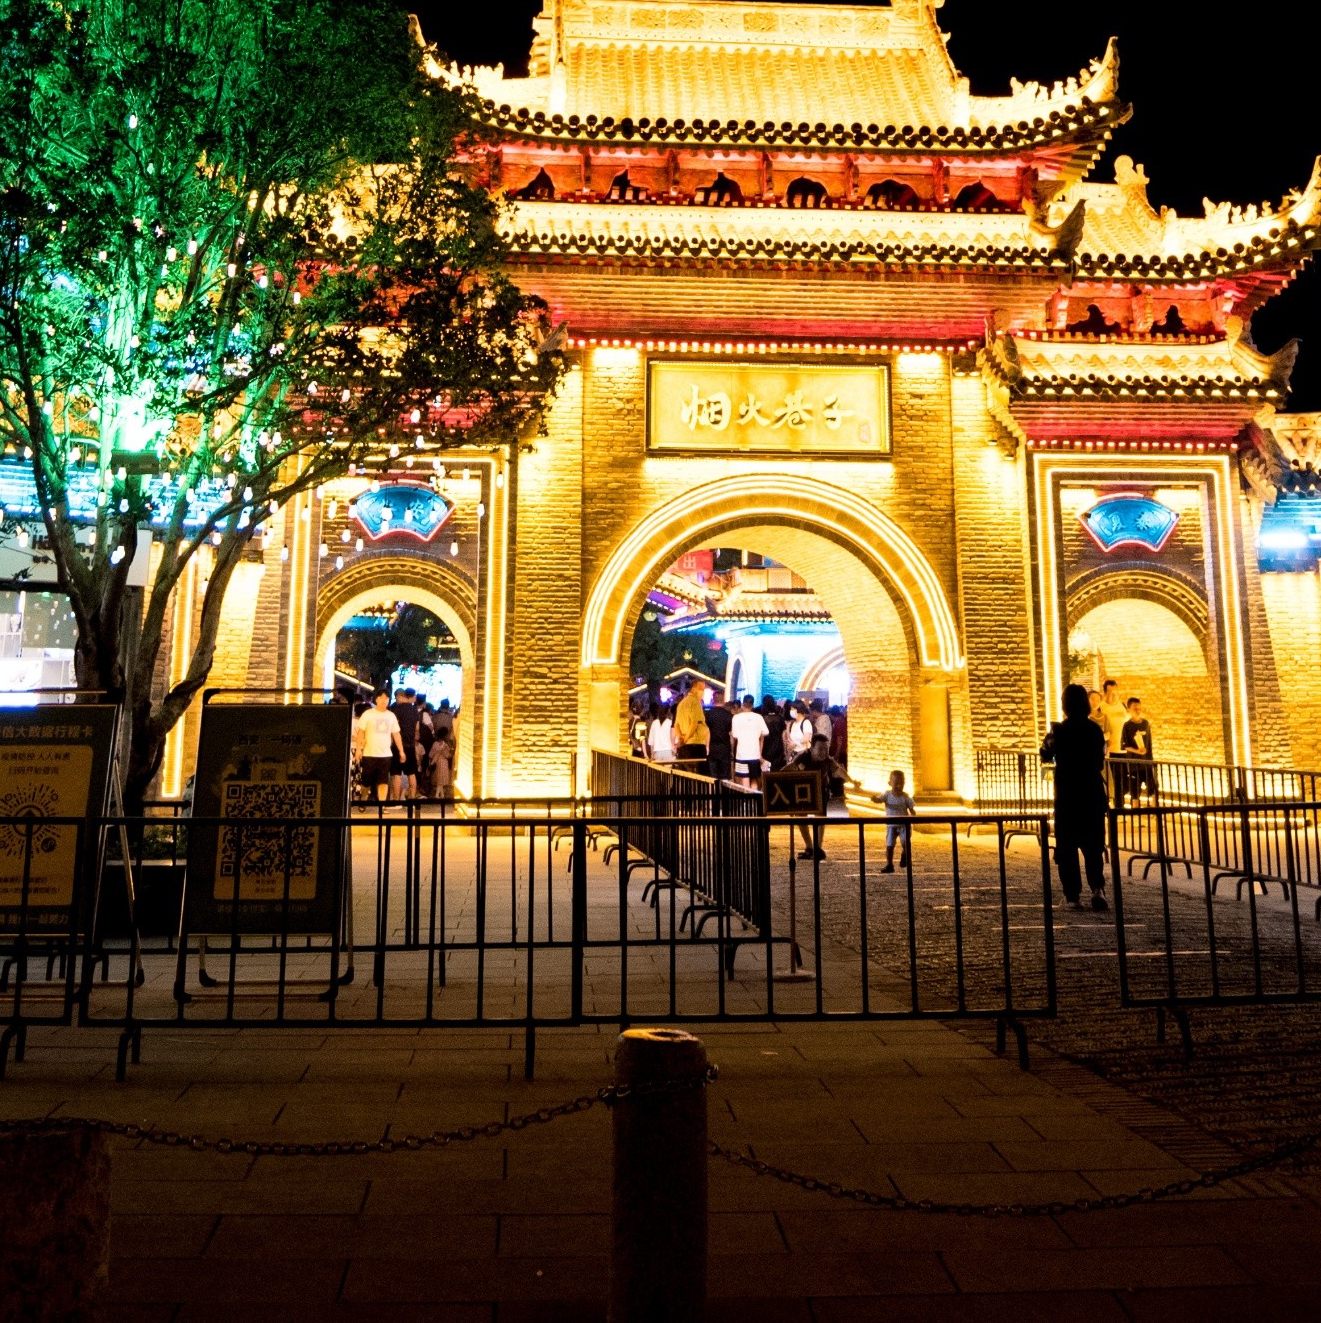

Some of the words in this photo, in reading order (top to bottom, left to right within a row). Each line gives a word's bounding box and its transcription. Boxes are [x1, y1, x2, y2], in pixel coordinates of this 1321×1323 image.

[680, 382, 856, 431] 烟火巷子
[770, 782, 812, 806] 入口
